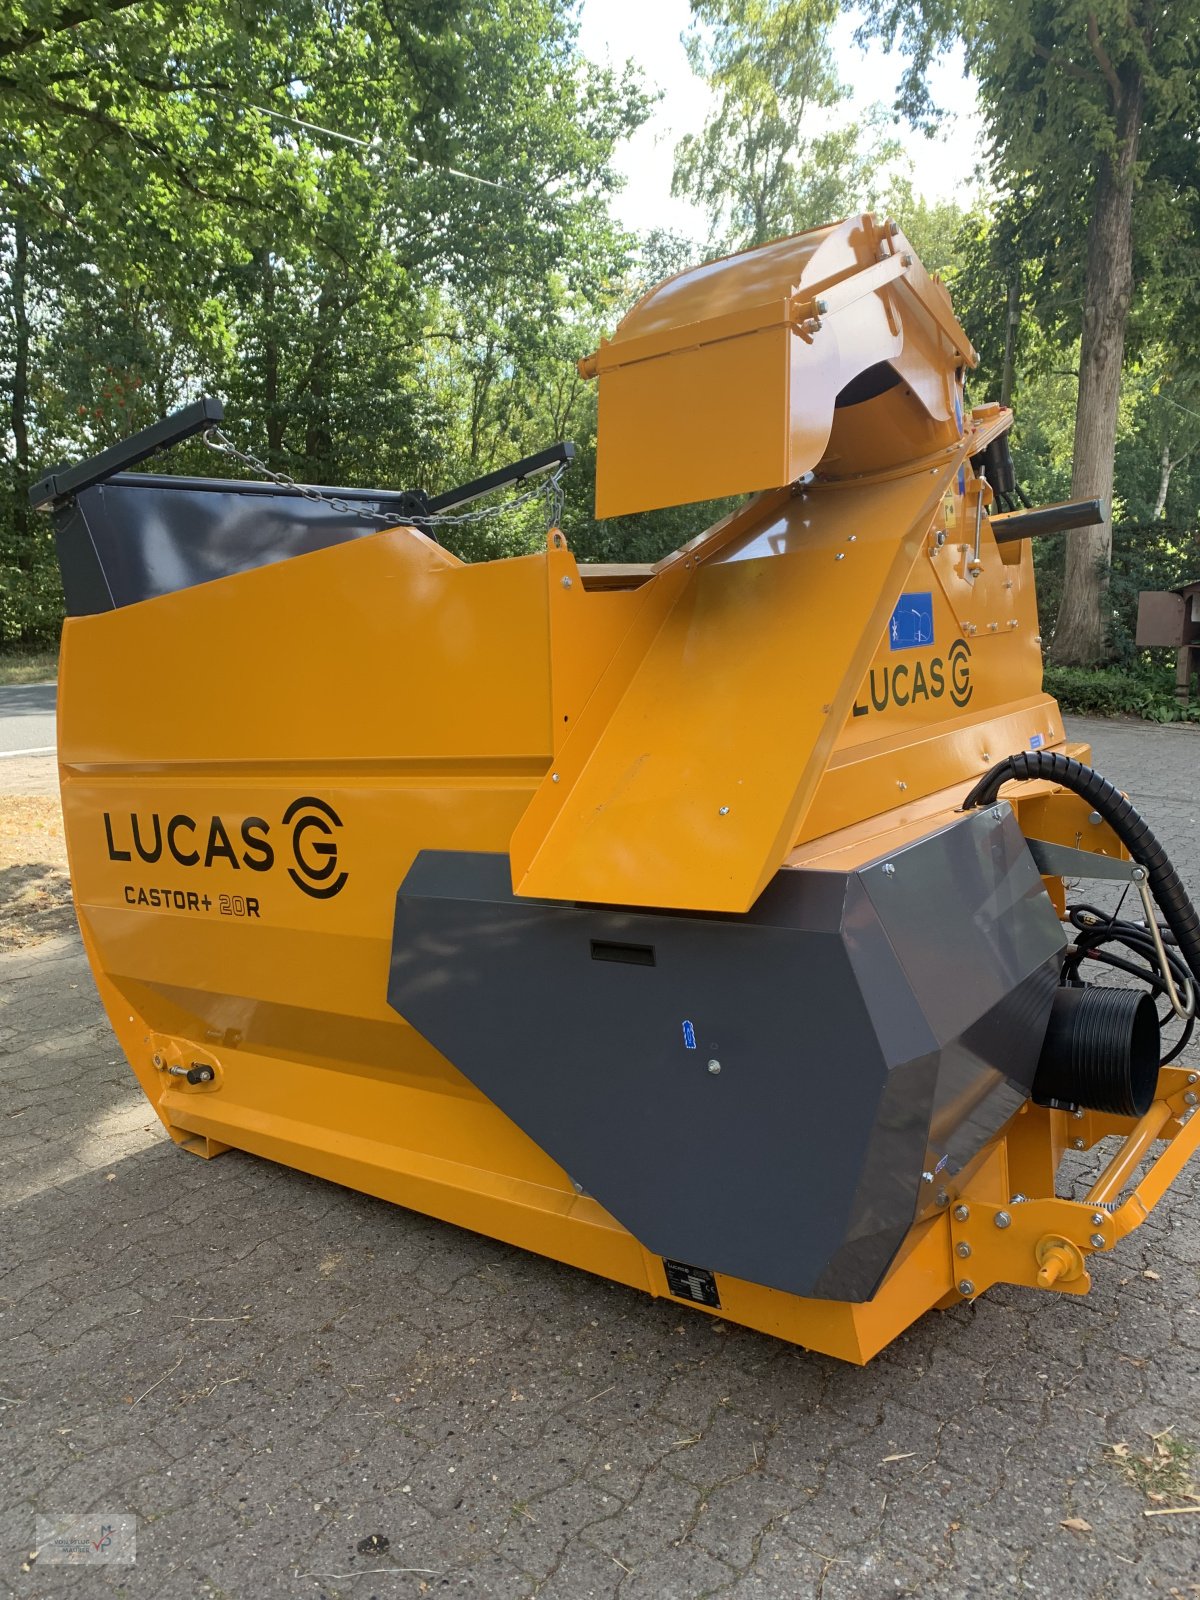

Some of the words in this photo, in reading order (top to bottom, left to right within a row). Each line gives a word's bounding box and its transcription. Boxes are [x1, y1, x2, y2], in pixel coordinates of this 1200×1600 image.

[103, 812, 275, 872] LUCAS
[124, 886, 212, 912] CASTOR+
[218, 894, 261, 918] 20R
